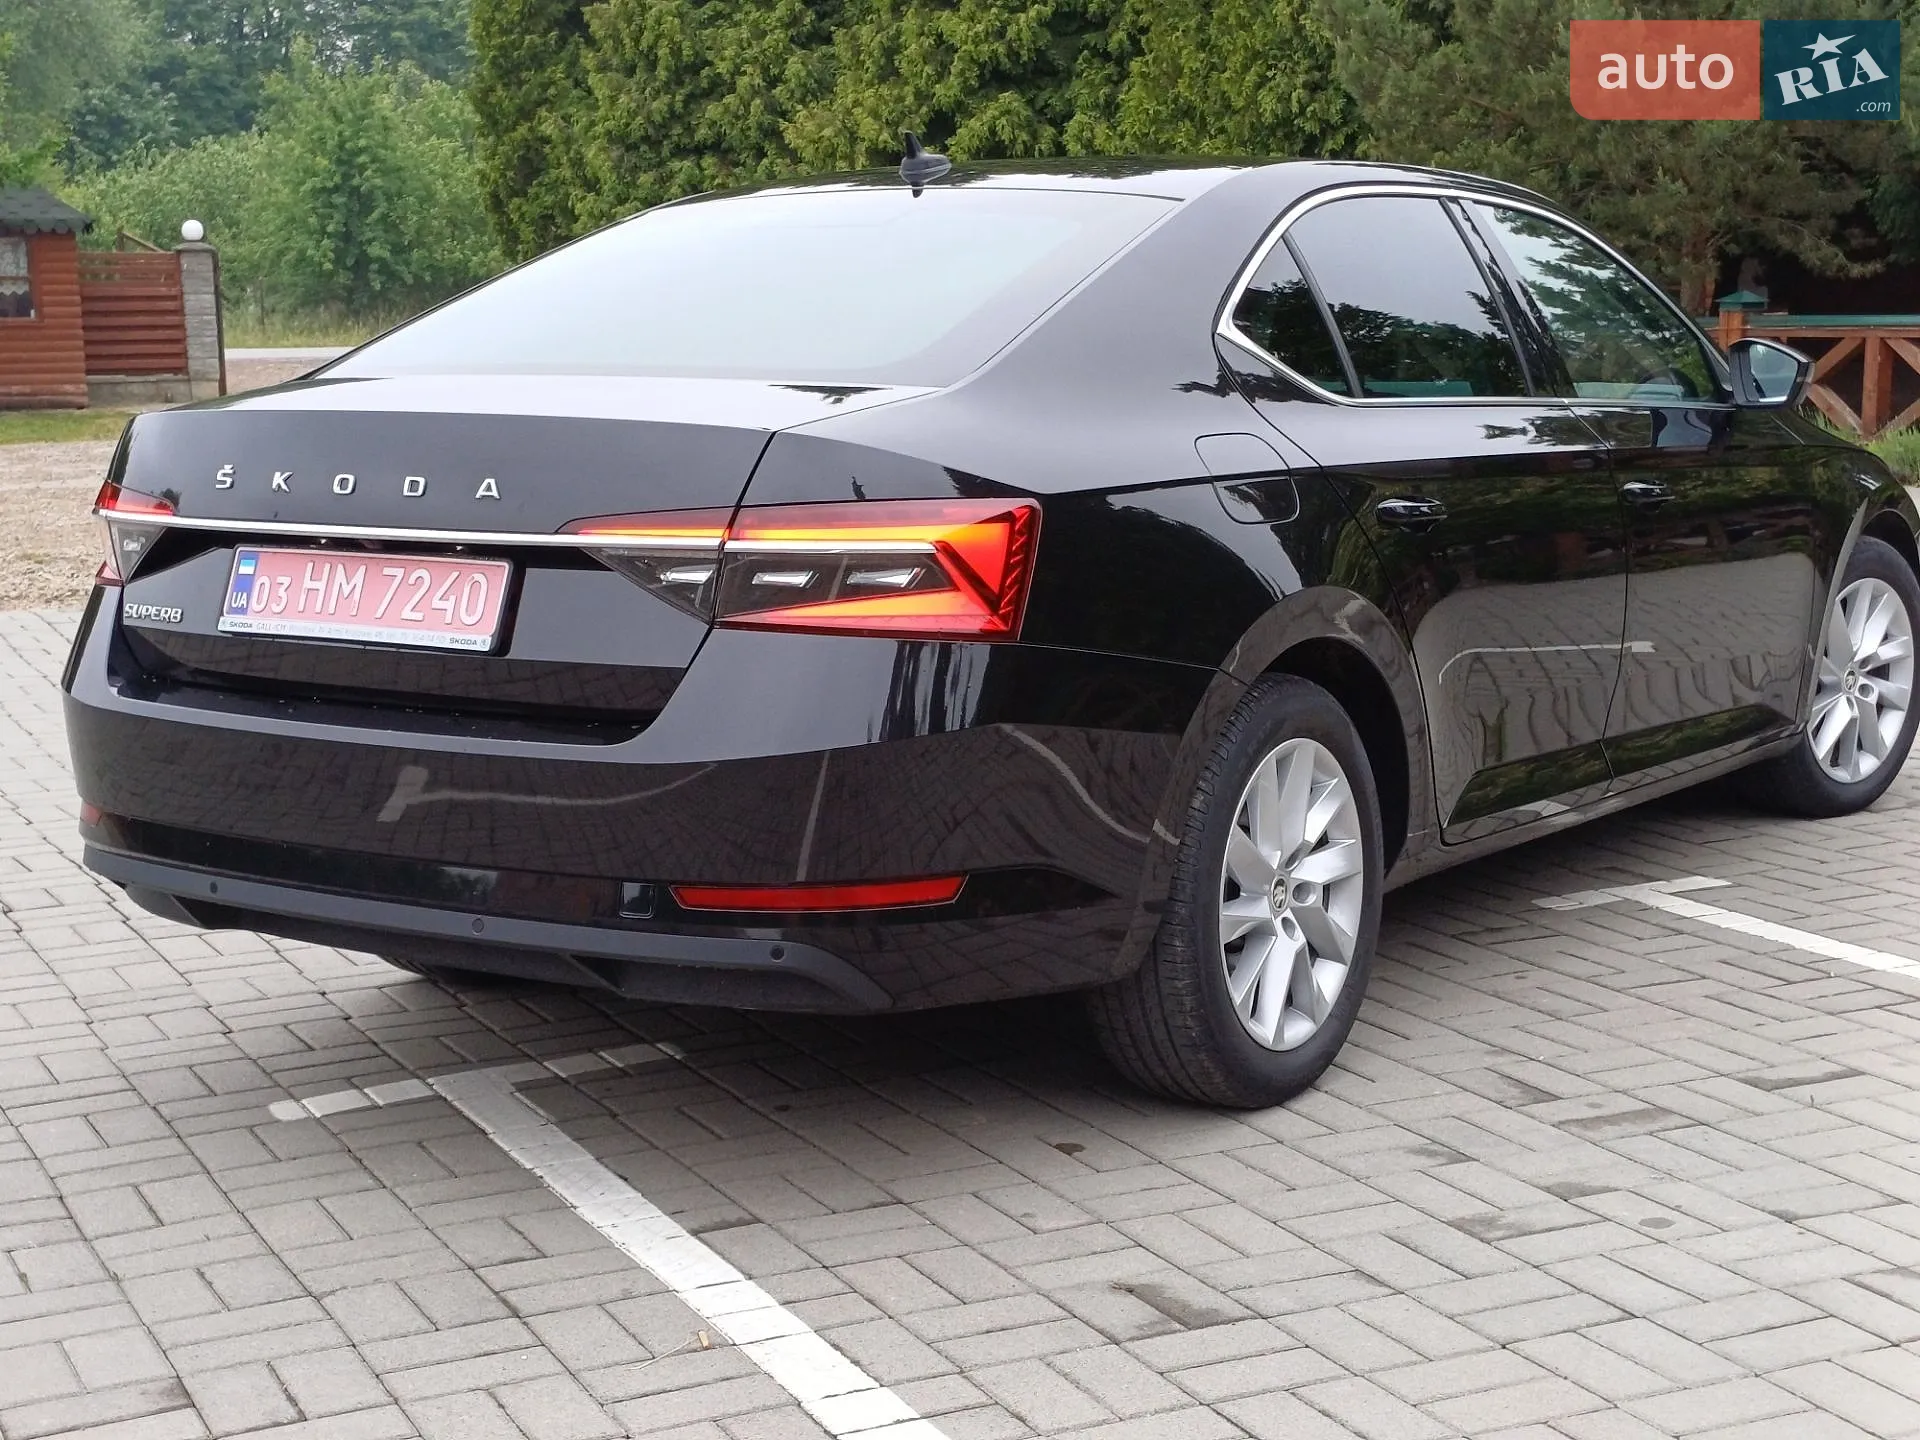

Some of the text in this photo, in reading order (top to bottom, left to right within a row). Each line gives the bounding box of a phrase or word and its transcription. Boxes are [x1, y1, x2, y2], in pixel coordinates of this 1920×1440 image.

[231, 591, 247, 609] UA
[251, 561, 489, 627] 03 HM 7240
[124, 603, 183, 623] SUPERB
